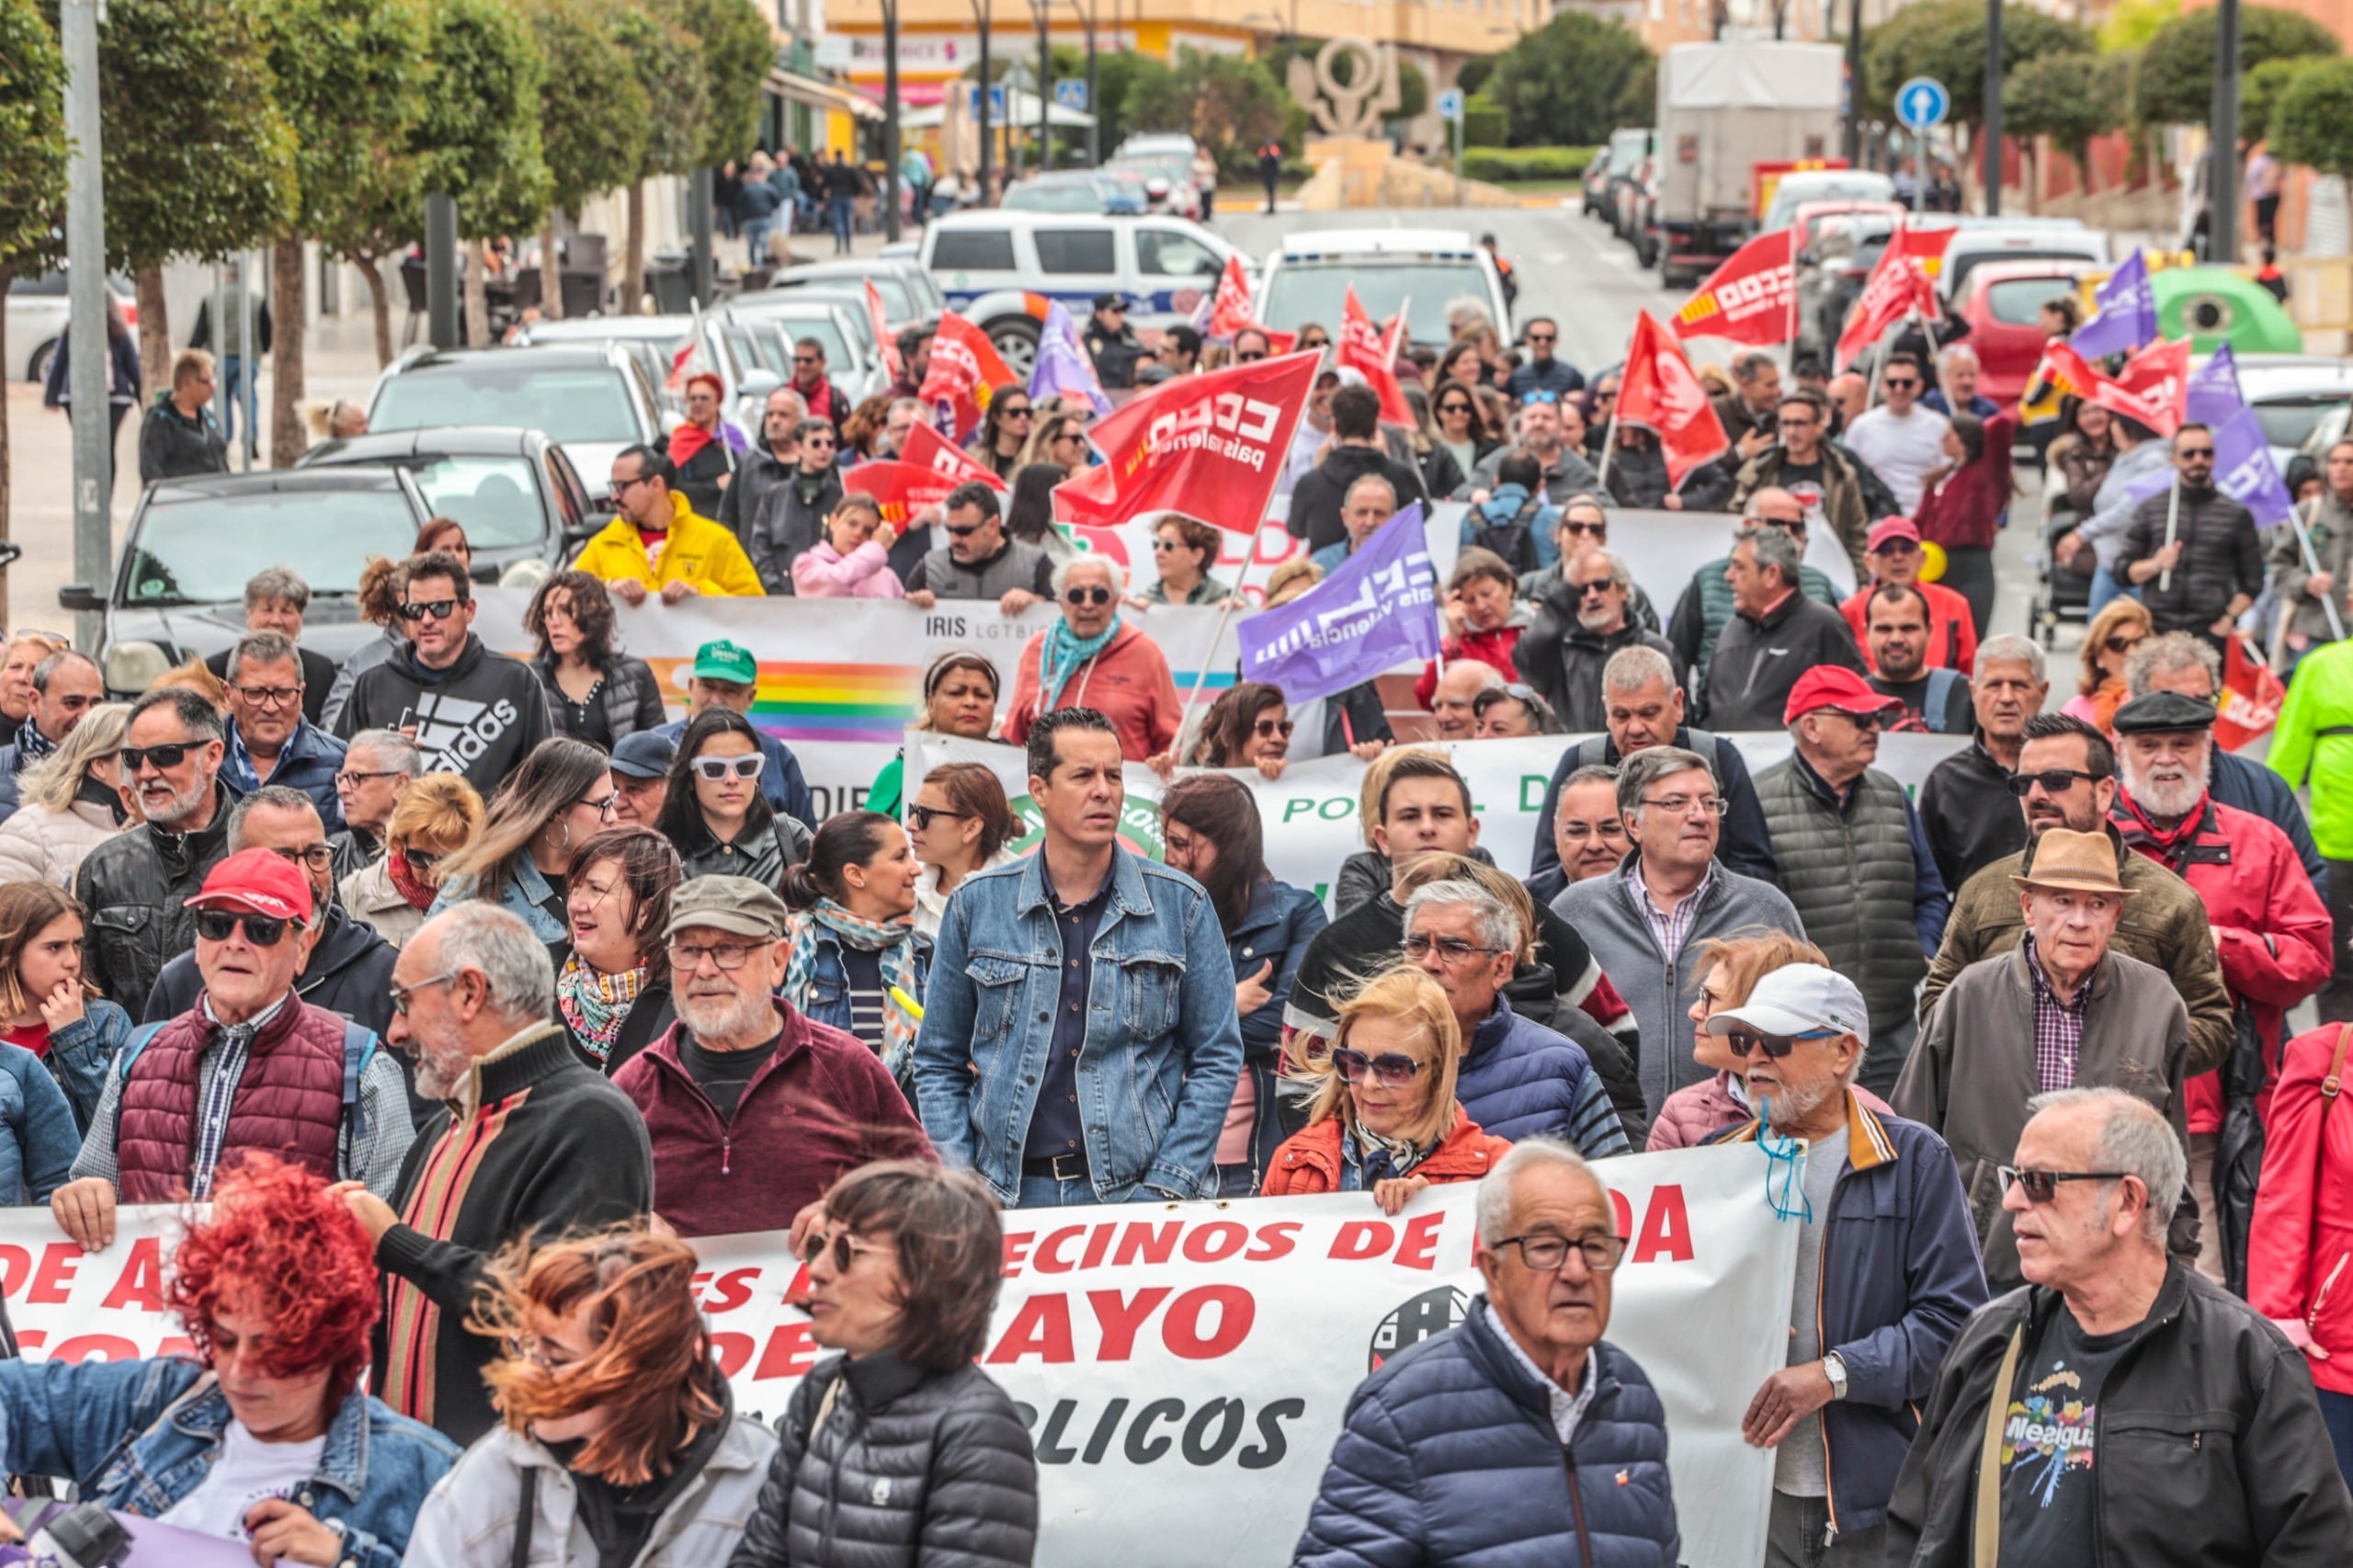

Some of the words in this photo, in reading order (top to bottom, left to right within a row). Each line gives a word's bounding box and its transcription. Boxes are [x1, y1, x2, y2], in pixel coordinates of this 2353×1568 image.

[926, 617, 966, 637] IRIS
[975, 625, 1047, 640] LGTBI
[434, 698, 517, 775] didas
[1000, 1221, 1305, 1279] ECINOS
[1327, 1210, 1446, 1270] DE
[974, 1284, 1256, 1365] AYO
[1011, 1396, 1306, 1470] LICOS
